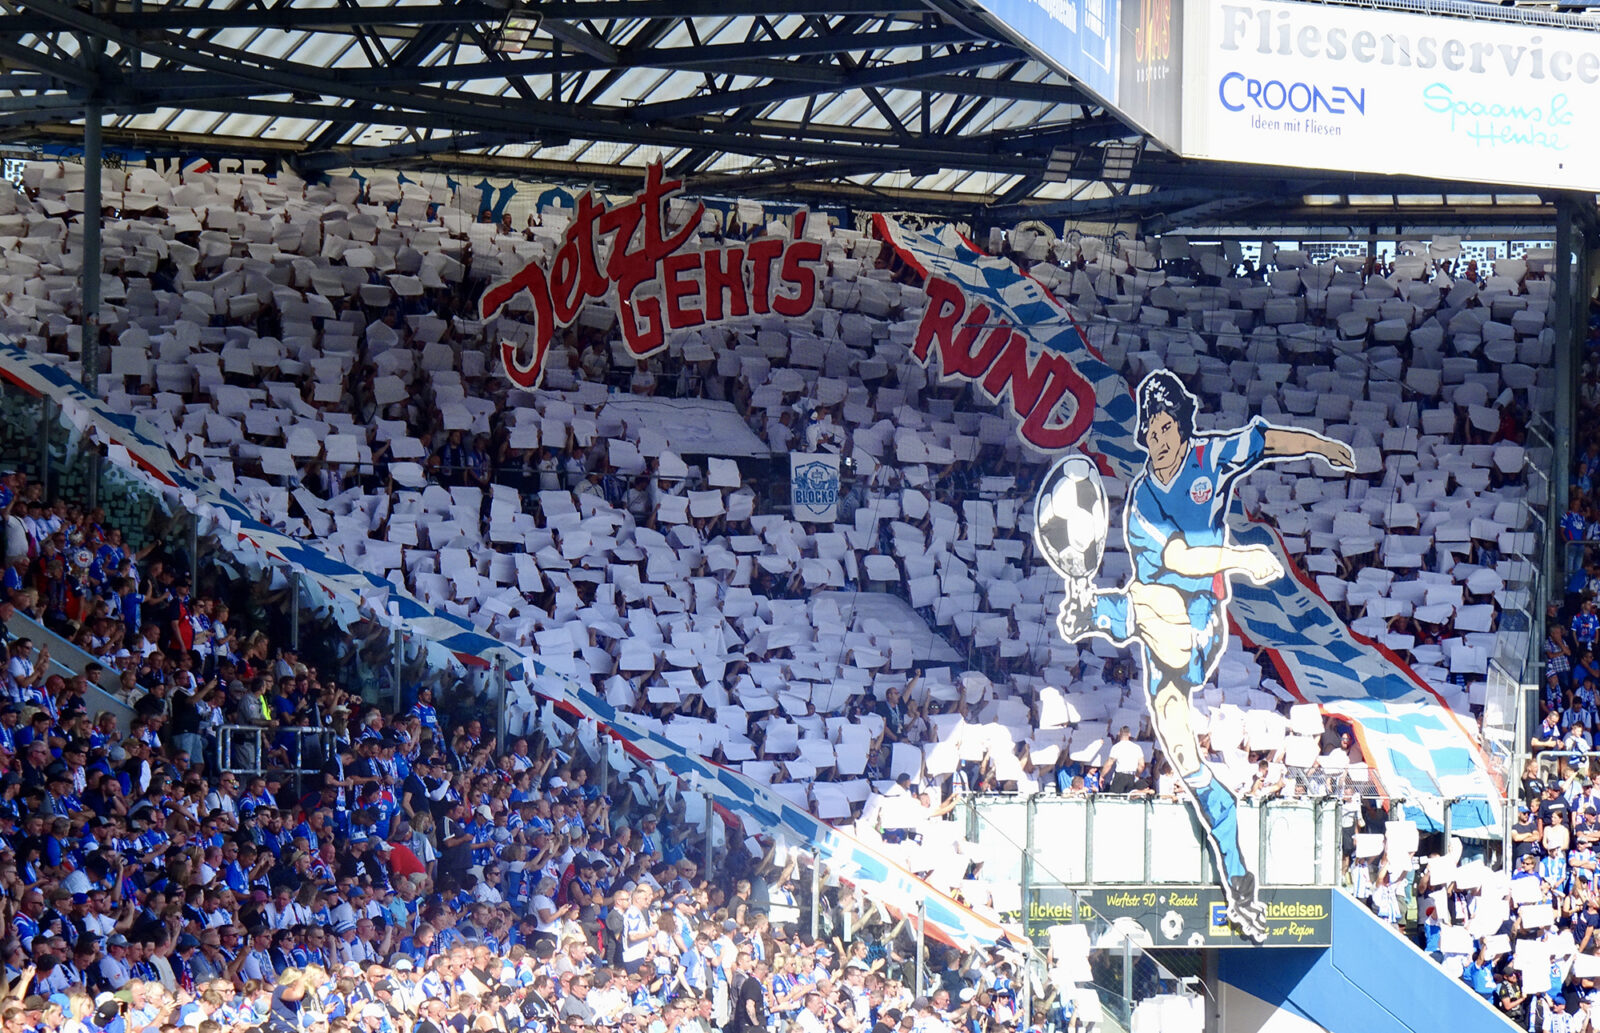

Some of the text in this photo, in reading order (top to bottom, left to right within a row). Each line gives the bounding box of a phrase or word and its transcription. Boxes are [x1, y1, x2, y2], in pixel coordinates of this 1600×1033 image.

[1220, 5, 1600, 84] Fliesenservice
[1219, 72, 1365, 116] CROONEN
[1423, 82, 1574, 132] Spaans &
[1251, 114, 1342, 136] Ideen mit Fliesen
[481, 158, 705, 388] Jetzt
[912, 277, 1097, 448] RUND
[1106, 893, 1199, 908] Werftstr. 50 Rostock
[1266, 901, 1324, 917] ickeisen
[1288, 922, 1315, 942] Region
